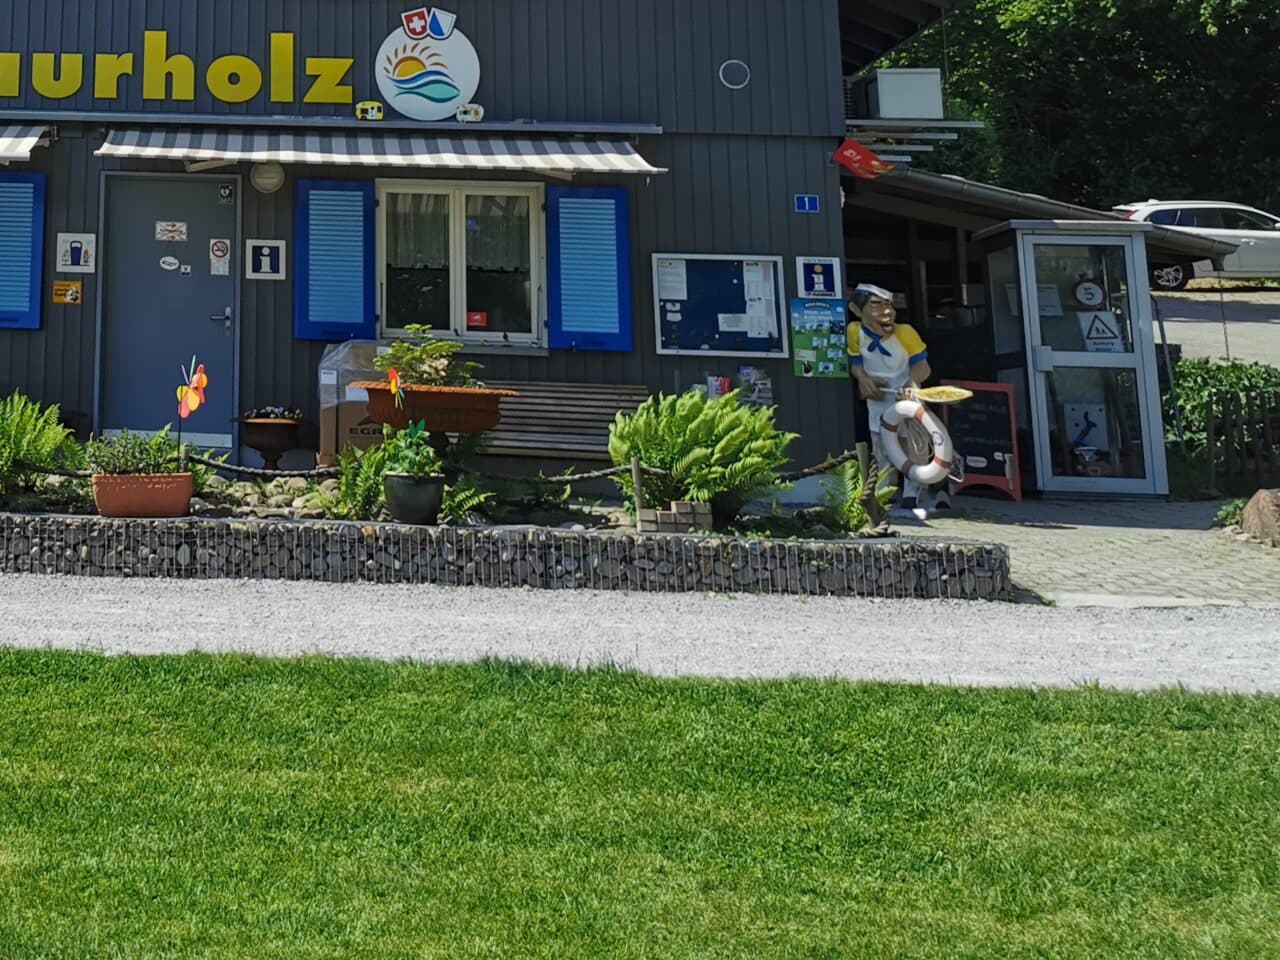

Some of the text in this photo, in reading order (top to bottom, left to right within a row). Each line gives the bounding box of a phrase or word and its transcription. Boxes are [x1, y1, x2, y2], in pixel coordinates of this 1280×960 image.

[804, 196, 809, 210] 1
[1084, 286, 1095, 301] 5
[349, 427, 383, 436] EGR
